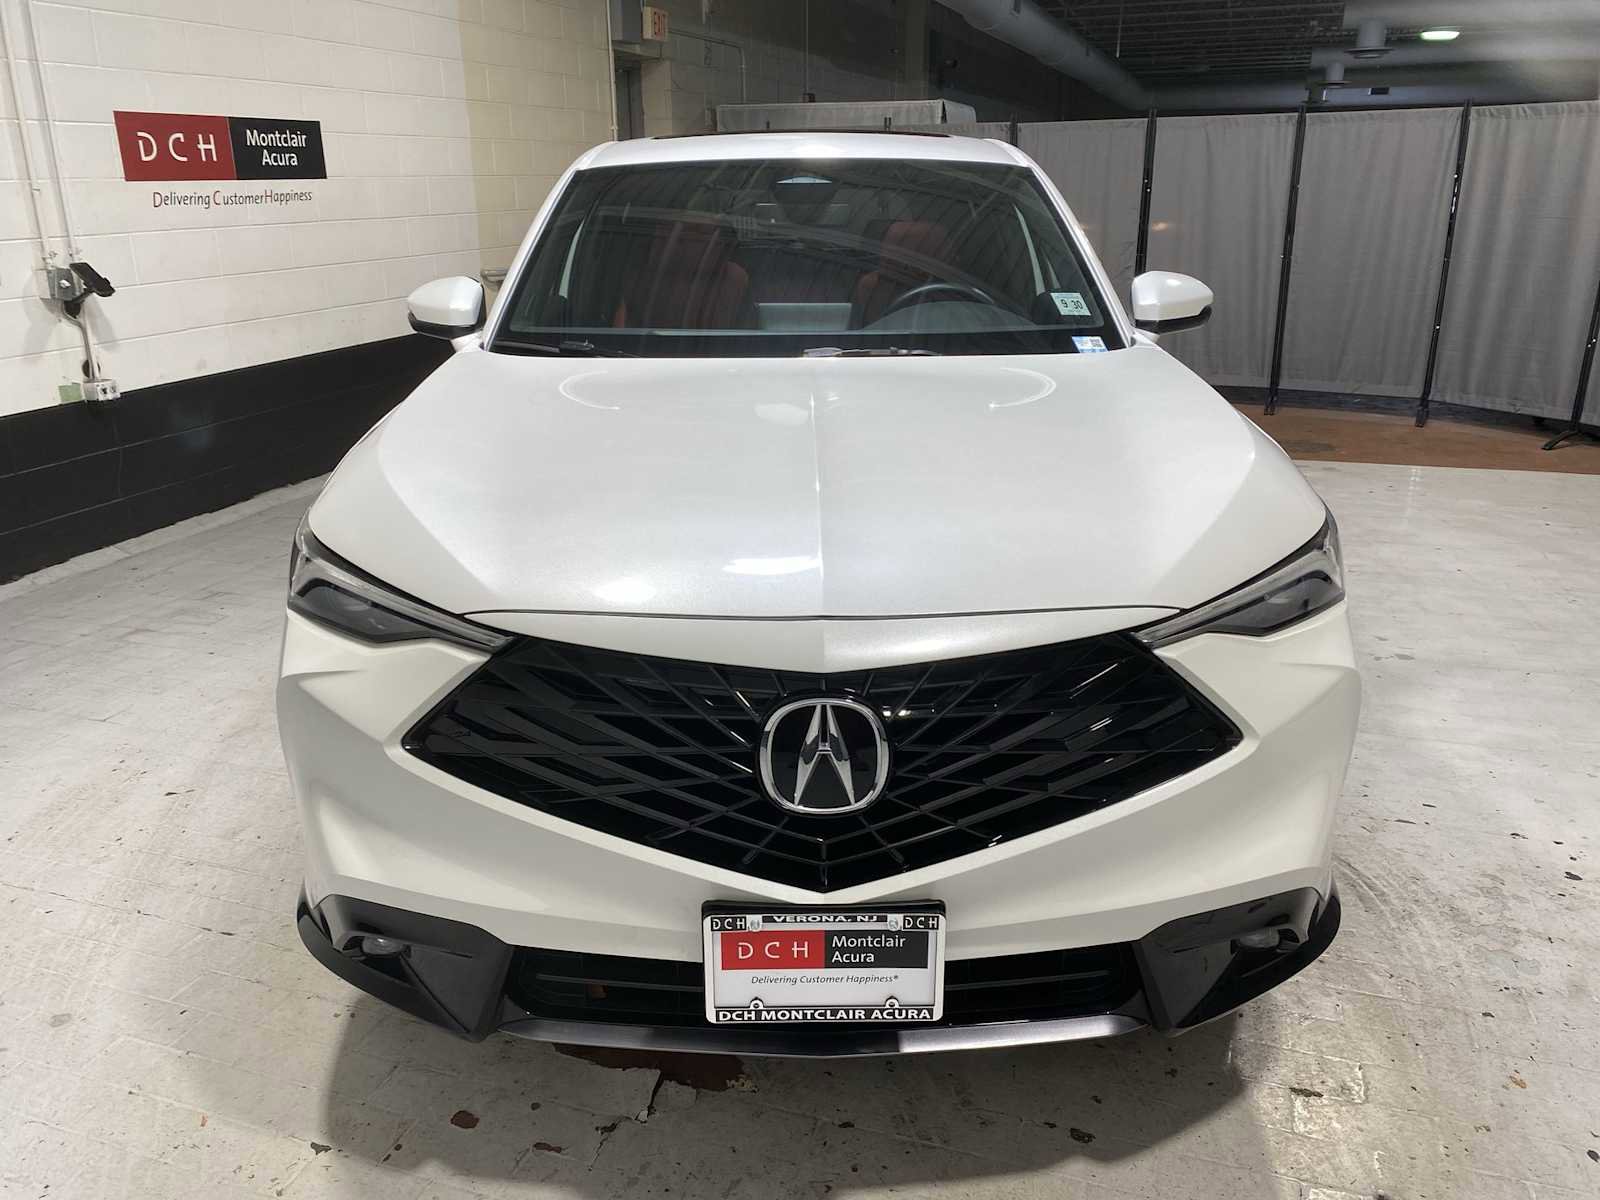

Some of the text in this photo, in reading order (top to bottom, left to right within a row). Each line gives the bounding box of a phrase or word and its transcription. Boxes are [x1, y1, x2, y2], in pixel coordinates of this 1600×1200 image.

[246, 129, 307, 148] Montclair
[262, 149, 299, 167] Acura
[153, 191, 211, 209] Delivering
[1060, 299, 1084, 310] 9 30
[712, 918, 746, 930] DCH
[904, 916, 938, 929] DCH
[831, 934, 906, 948] Montclair
[831, 951, 875, 963] Acura
[751, 975, 798, 985] Delivering
[799, 975, 845, 984] Customer
[719, 1009, 931, 1021] DCH MONTCLAIR ACURA
